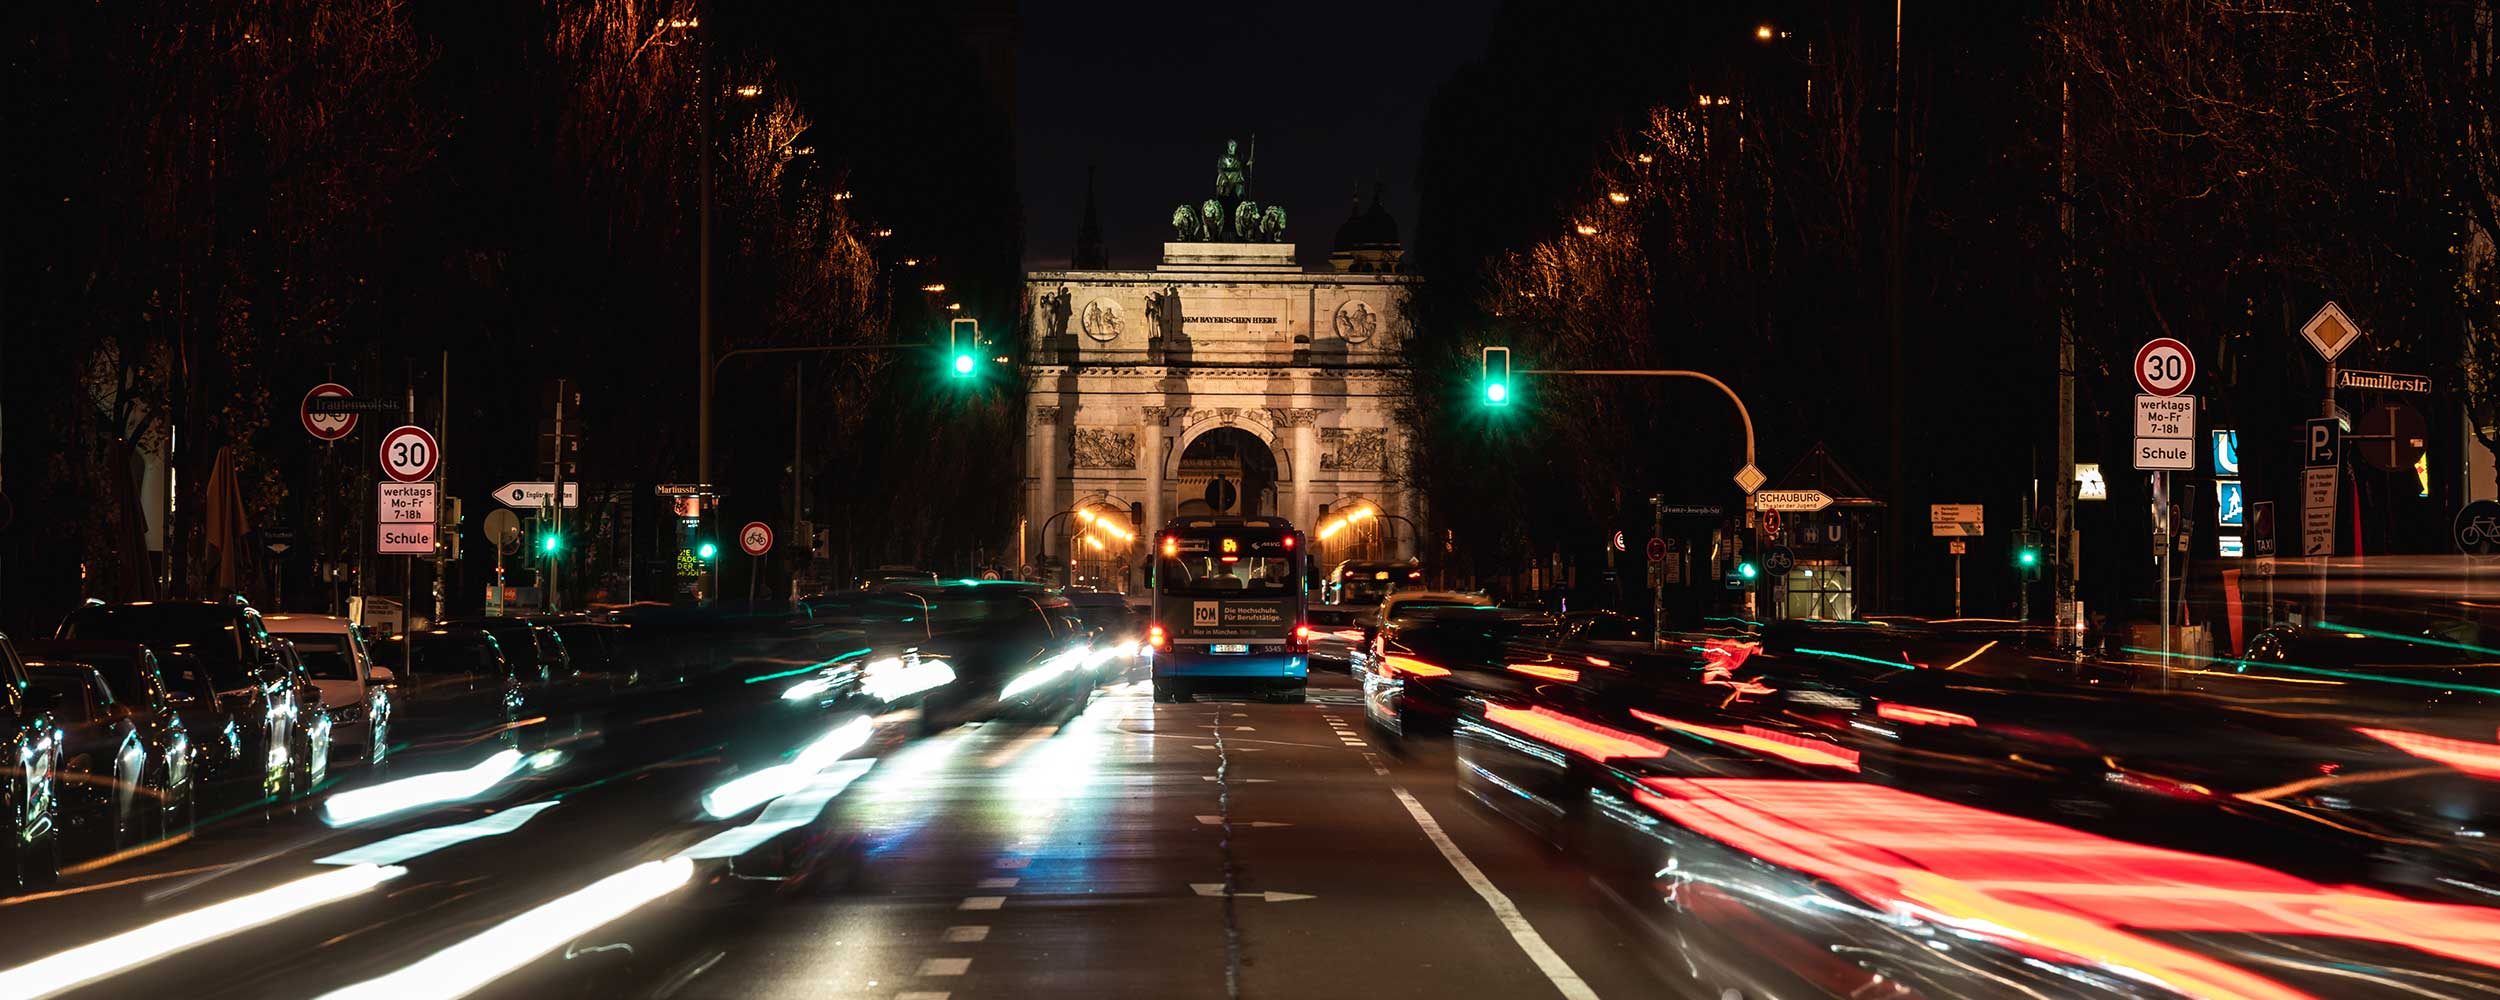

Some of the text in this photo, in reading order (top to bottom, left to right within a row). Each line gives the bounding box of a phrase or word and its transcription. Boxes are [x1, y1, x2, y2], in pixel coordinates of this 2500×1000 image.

[2148, 355, 2181, 381] 30
[2340, 371, 2428, 392] Ainmillerstr.
[2140, 400, 2191, 412] werktags
[2148, 412, 2181, 422] Mo-Fr
[2151, 424, 2179, 433] 7-18h
[2311, 425, 2330, 462] P
[393, 442, 425, 467] 30
[2142, 447, 2187, 459] Schule
[383, 488, 432, 498] werktags
[657, 486, 697, 495] Martiusstr.
[1759, 493, 1820, 503] SCHAUBURG
[391, 499, 423, 508] Mo-Fr
[394, 510, 421, 519] 7-18h
[385, 532, 429, 544] Schule
[1828, 525, 1841, 543] U
[2256, 539, 2273, 550] TAXI
[1196, 608, 1216, 620] FOM
[1238, 607, 1278, 615] Hochschule.
[1224, 613, 1282, 622] Für Berufstätige.
[1264, 645, 1282, 653] 5545
